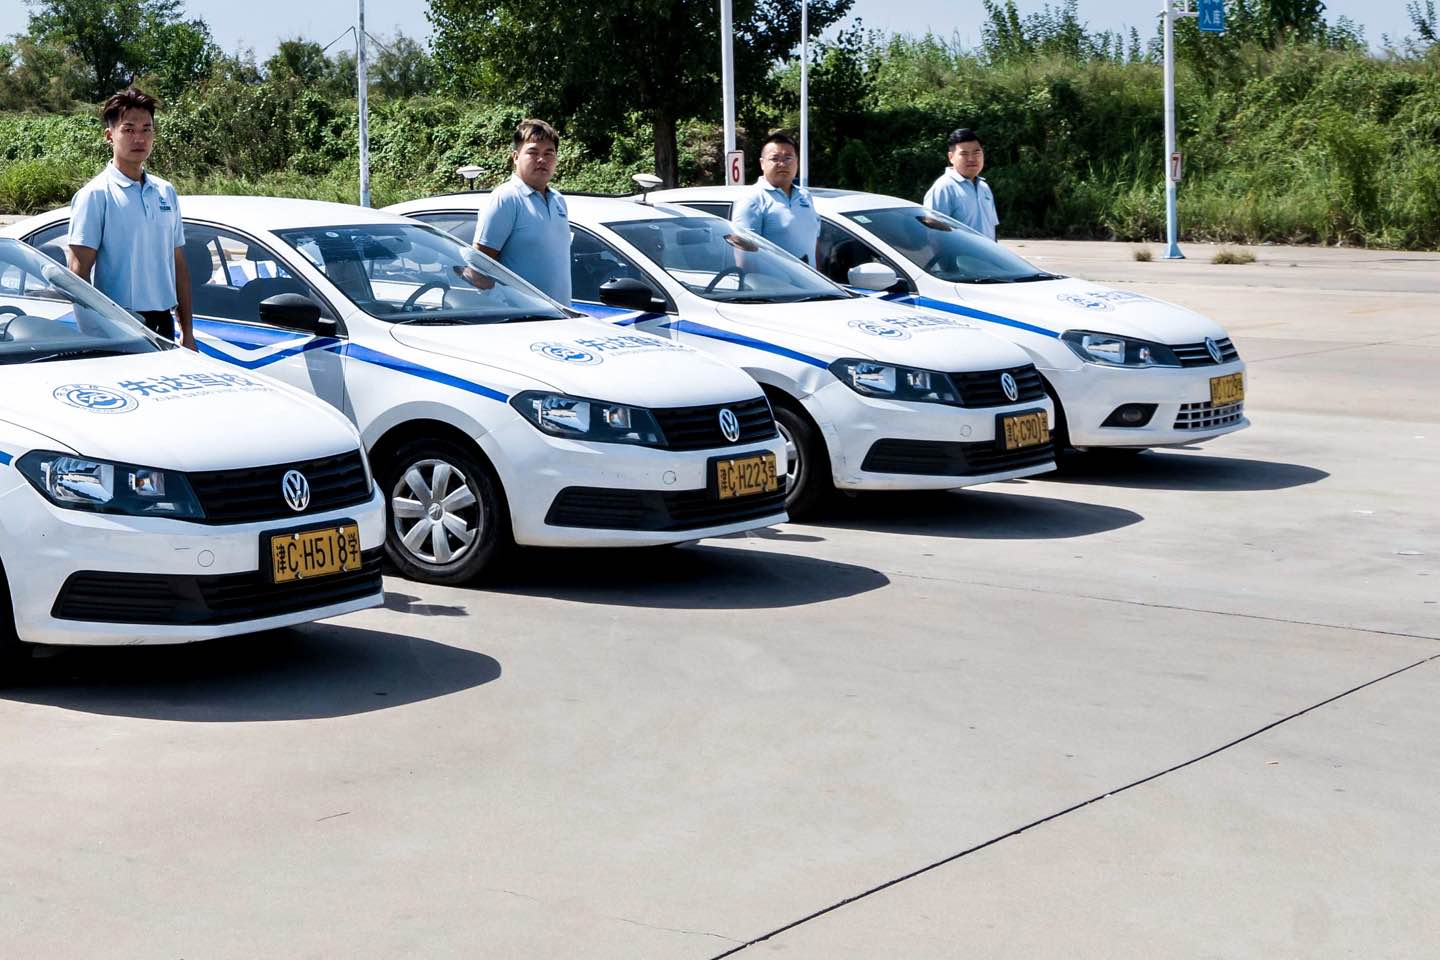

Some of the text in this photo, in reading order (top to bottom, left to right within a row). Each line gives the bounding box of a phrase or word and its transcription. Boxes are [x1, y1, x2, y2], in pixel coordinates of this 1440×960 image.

[732, 157, 740, 183] 6
[117, 373, 262, 397] 先达驾校
